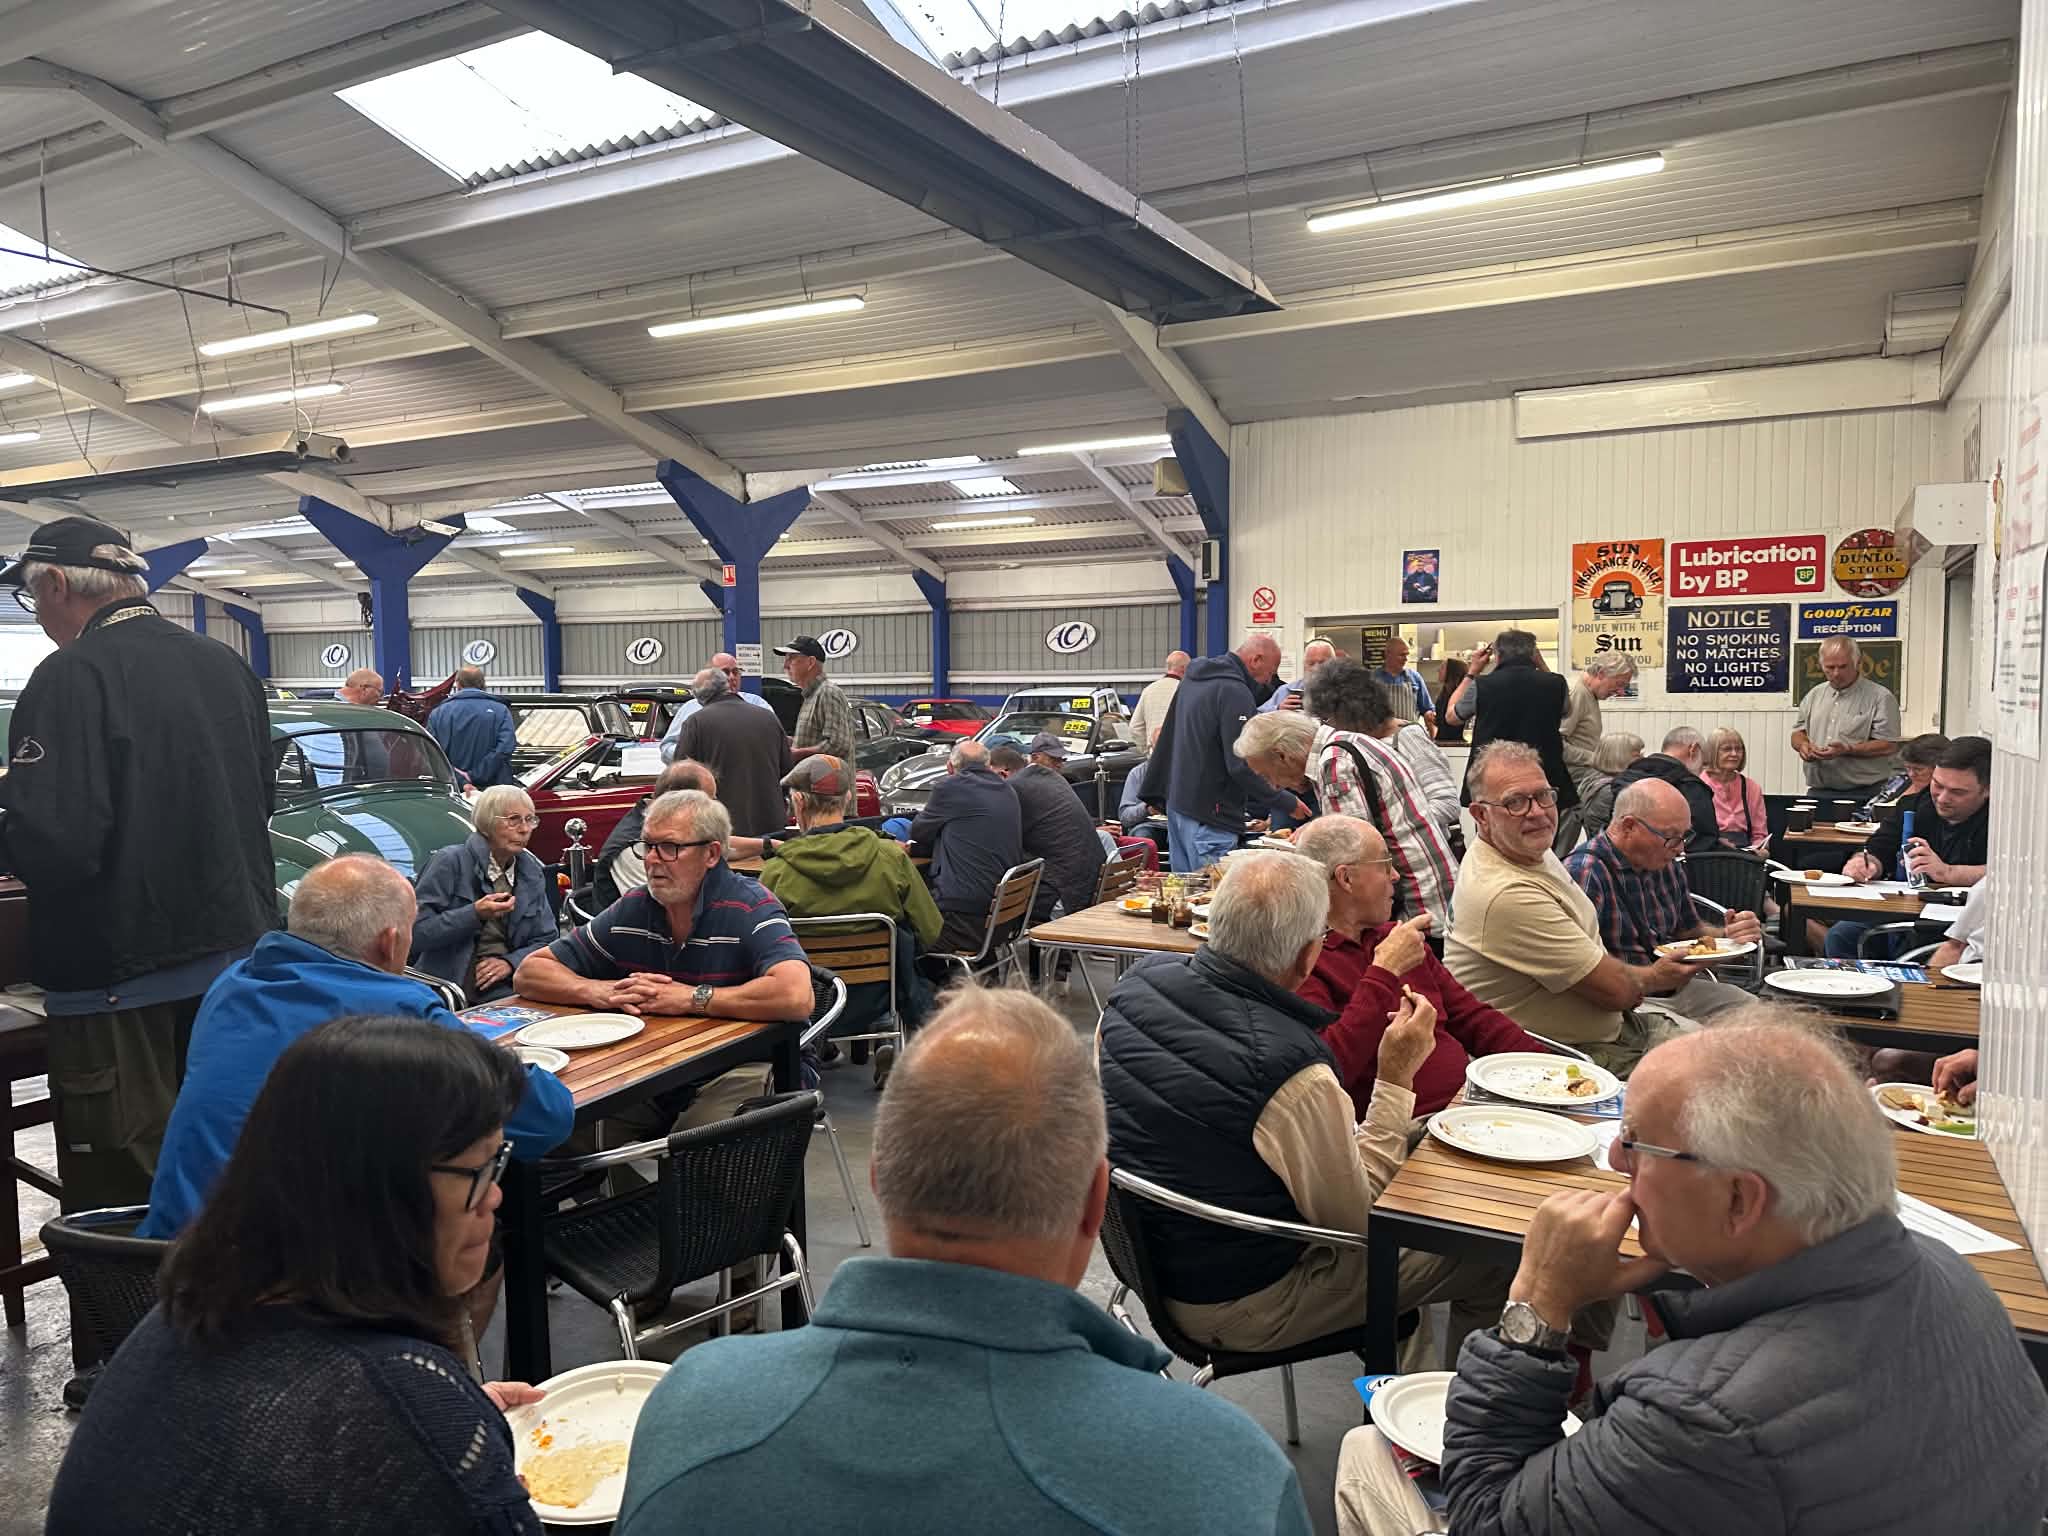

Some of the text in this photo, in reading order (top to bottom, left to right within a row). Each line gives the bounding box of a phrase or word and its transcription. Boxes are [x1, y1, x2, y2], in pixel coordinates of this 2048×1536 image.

[1597, 543, 1640, 558] SUN
[1680, 543, 1816, 567] Lubrication
[1840, 552, 1901, 564] DUNLO
[1576, 556, 1663, 589] INSURANCE OFFICE
[1800, 571, 1813, 579] BP
[1848, 565, 1895, 574] STOCK
[1679, 571, 1710, 594] by
[1687, 609, 1771, 628] NOTICE
[1612, 622, 1636, 632] WITH
[1641, 621, 1659, 630] THE
[1813, 624, 1882, 634] RECEPTION
[1594, 634, 1643, 654] Sun
[1676, 633, 1781, 646] NO SMOKING
[1676, 647, 1780, 659] NO MATCHES
[1685, 662, 1771, 673] NO LIGHTS
[1689, 676, 1765, 687] ALLOWED
